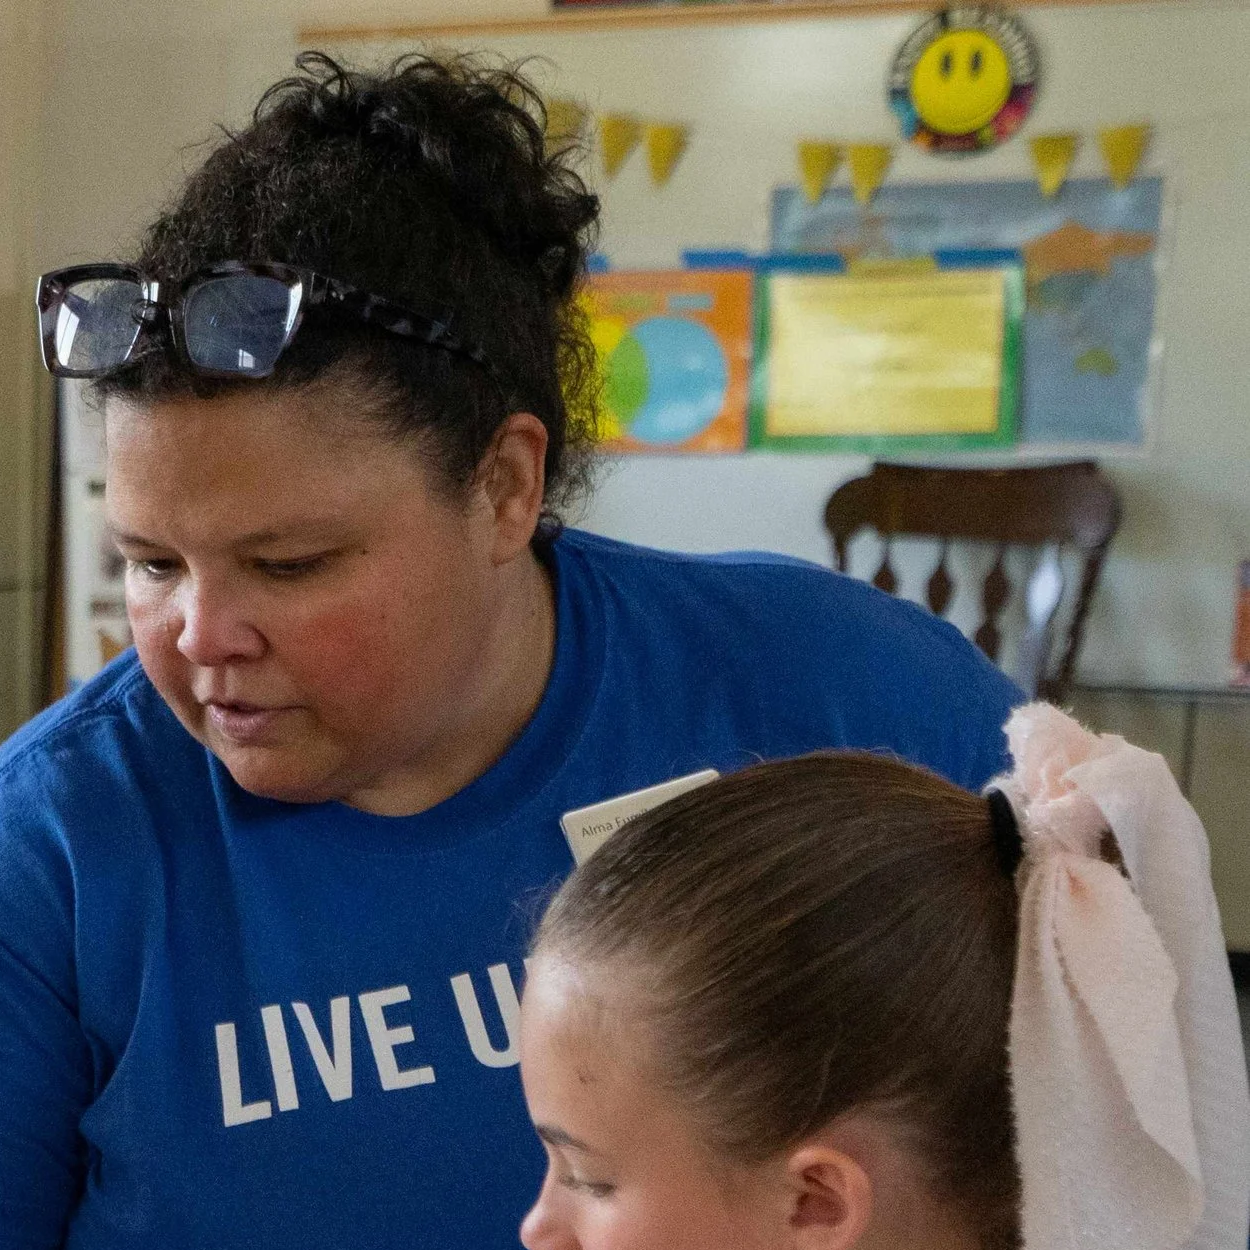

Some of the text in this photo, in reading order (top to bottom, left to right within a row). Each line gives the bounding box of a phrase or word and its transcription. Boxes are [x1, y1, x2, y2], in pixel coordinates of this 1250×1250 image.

[581, 821, 613, 838] Alma
[215, 960, 528, 1127] LIVE U
